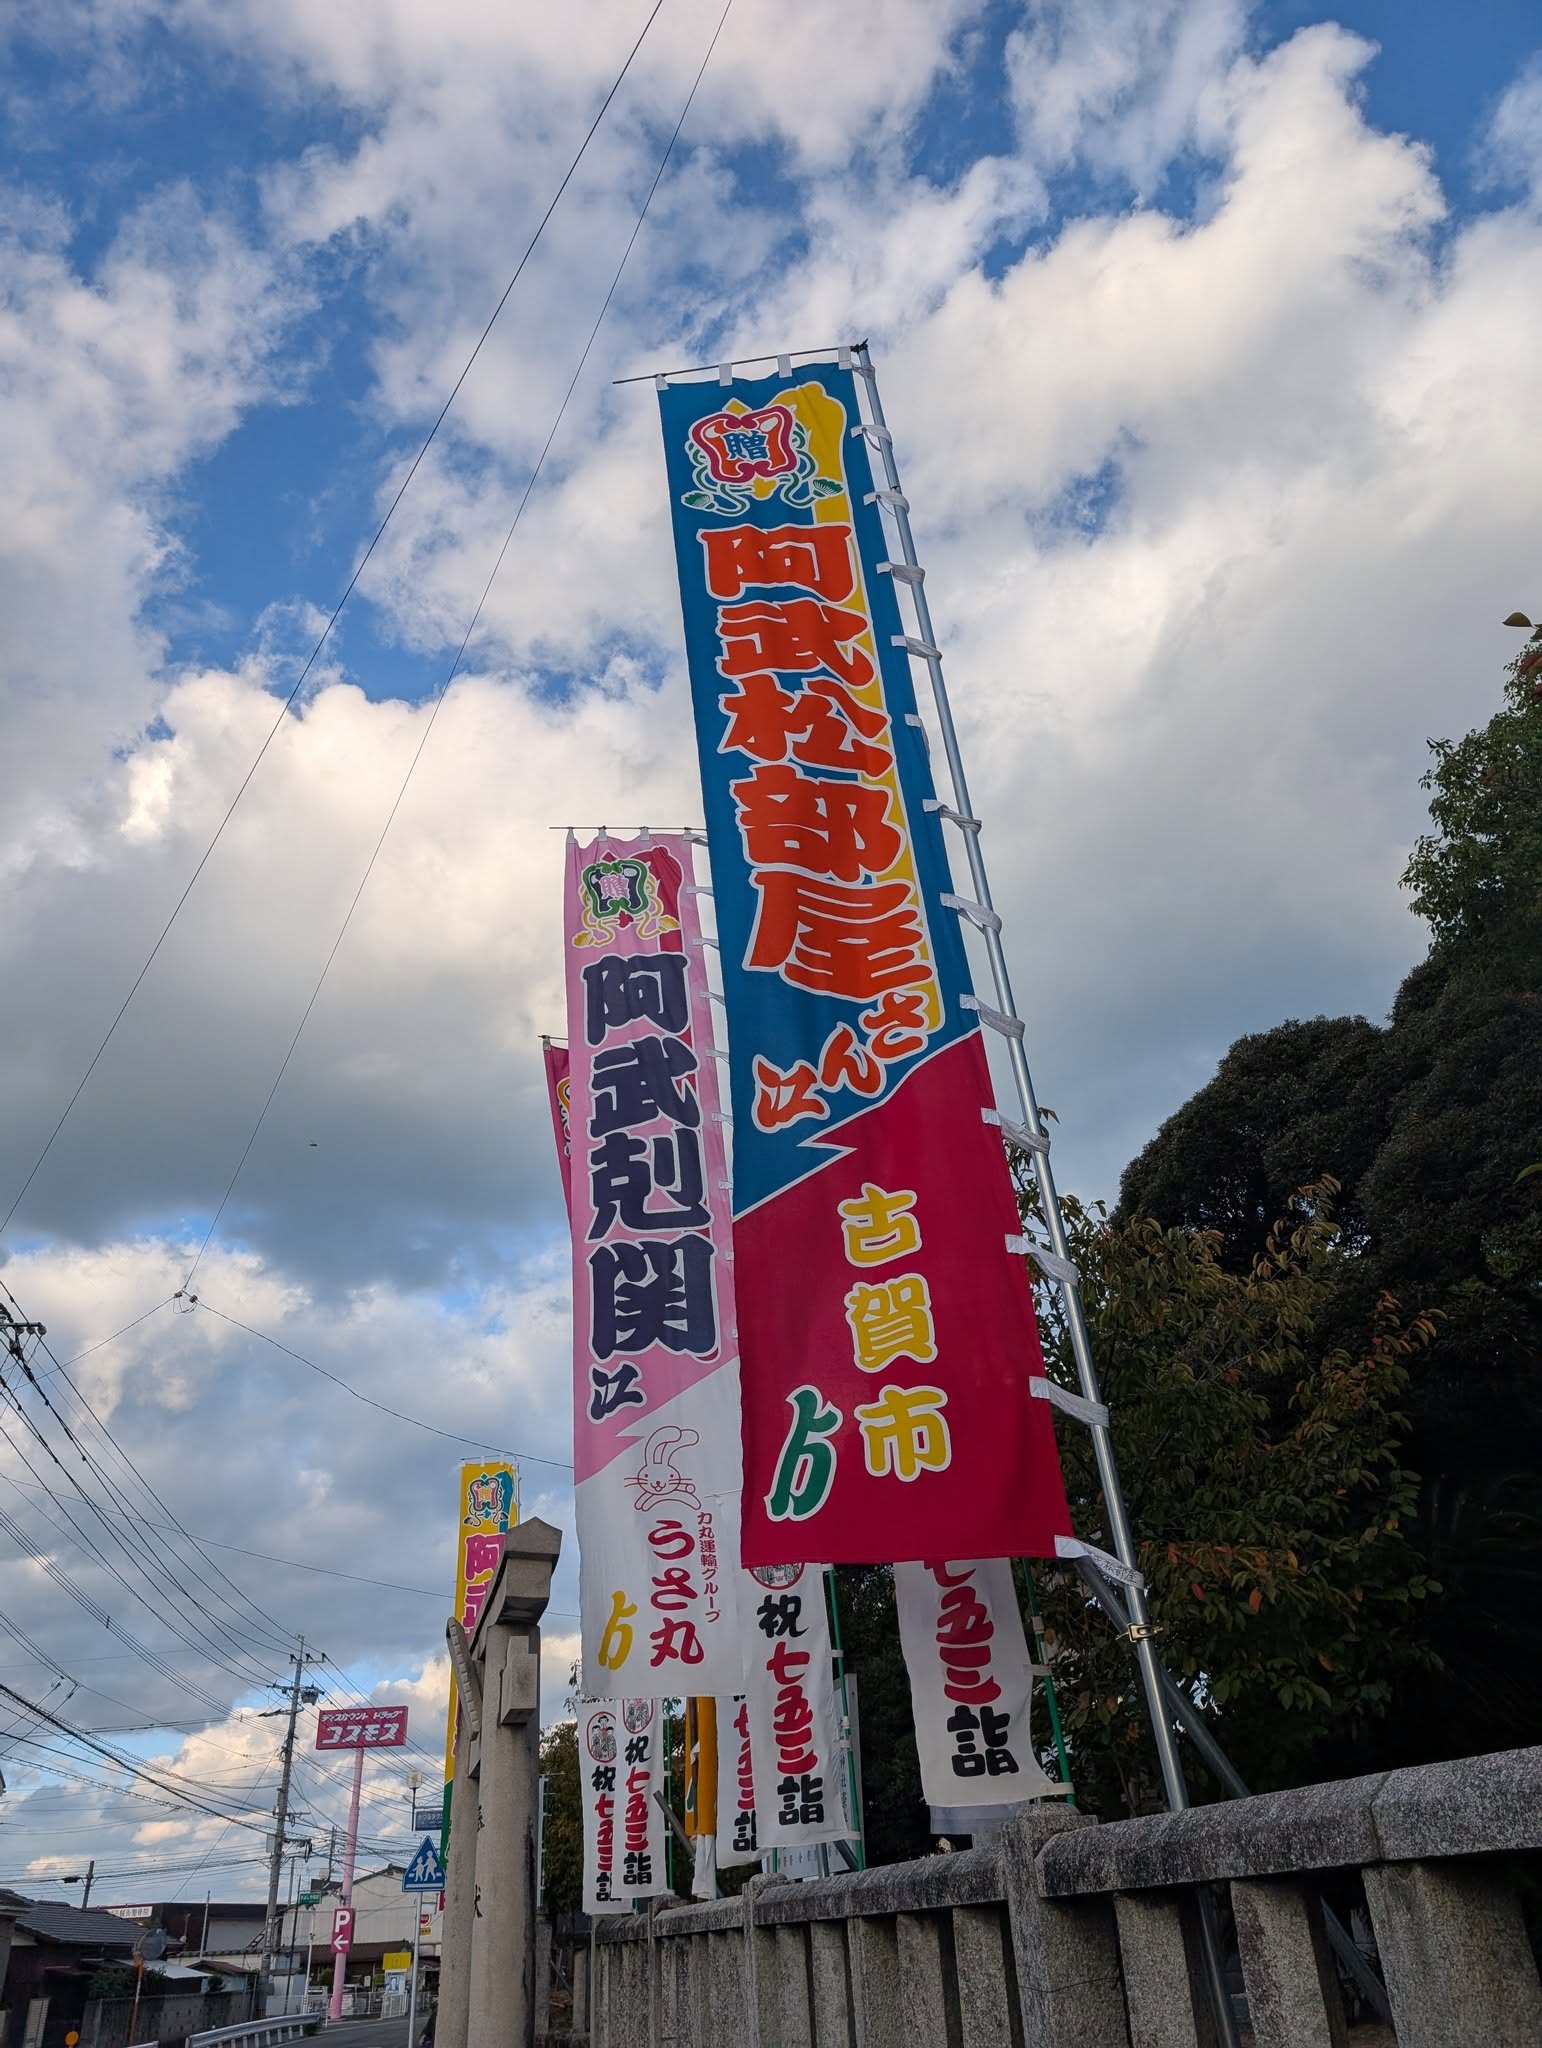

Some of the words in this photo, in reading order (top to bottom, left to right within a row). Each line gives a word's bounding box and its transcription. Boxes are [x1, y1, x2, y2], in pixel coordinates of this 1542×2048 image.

[723, 431, 768, 462] 贈
[838, 1182, 951, 1482] 古賀市
[321, 1722, 400, 1744] コスモス
[756, 1594, 825, 1825] 祝七五三詣
[622, 1735, 652, 1885] 祝七五三詣
[334, 1910, 351, 1933] P
